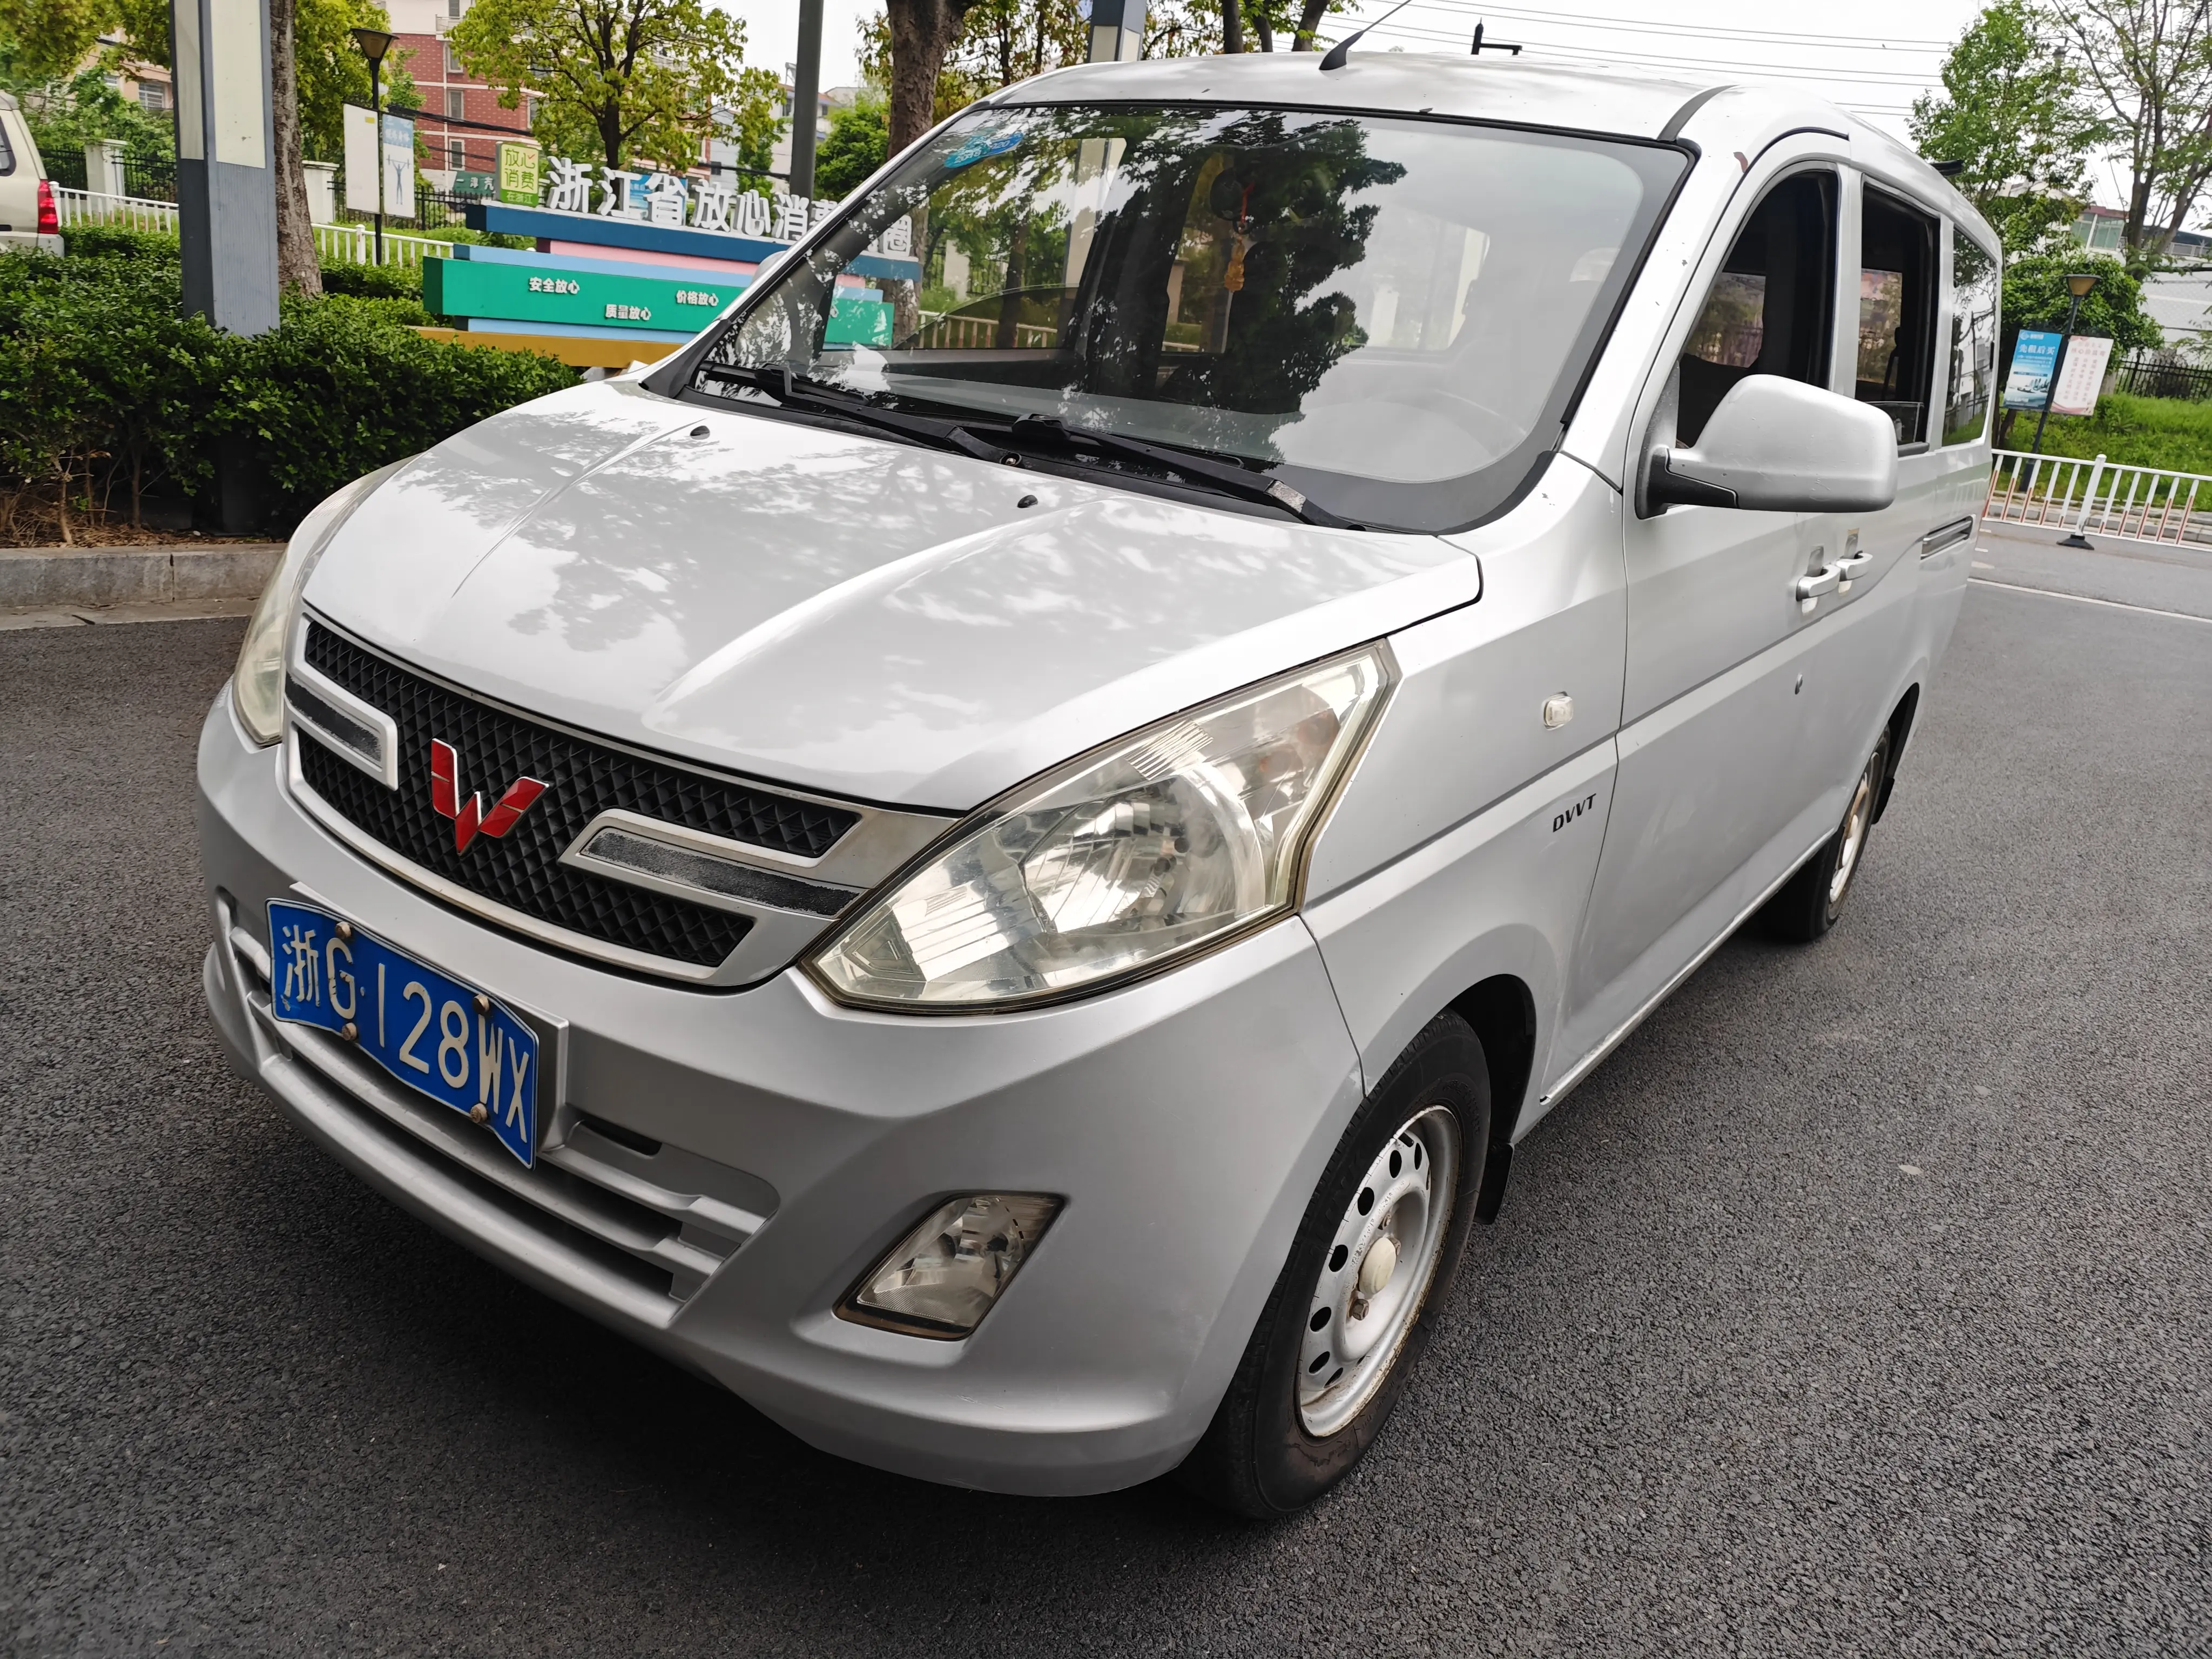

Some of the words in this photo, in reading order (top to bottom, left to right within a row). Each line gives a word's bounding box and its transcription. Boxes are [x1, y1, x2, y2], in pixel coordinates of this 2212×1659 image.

[505, 148, 535, 168] 放心
[504, 168, 535, 190] 消费
[507, 191, 532, 204] 在浙江
[547, 156, 912, 257] 浙江省放心消圈
[529, 277, 580, 295] 安全放心
[676, 290, 719, 306] 价格放心
[605, 304, 651, 321] 质量放心
[1553, 793, 1597, 833] DVVT
